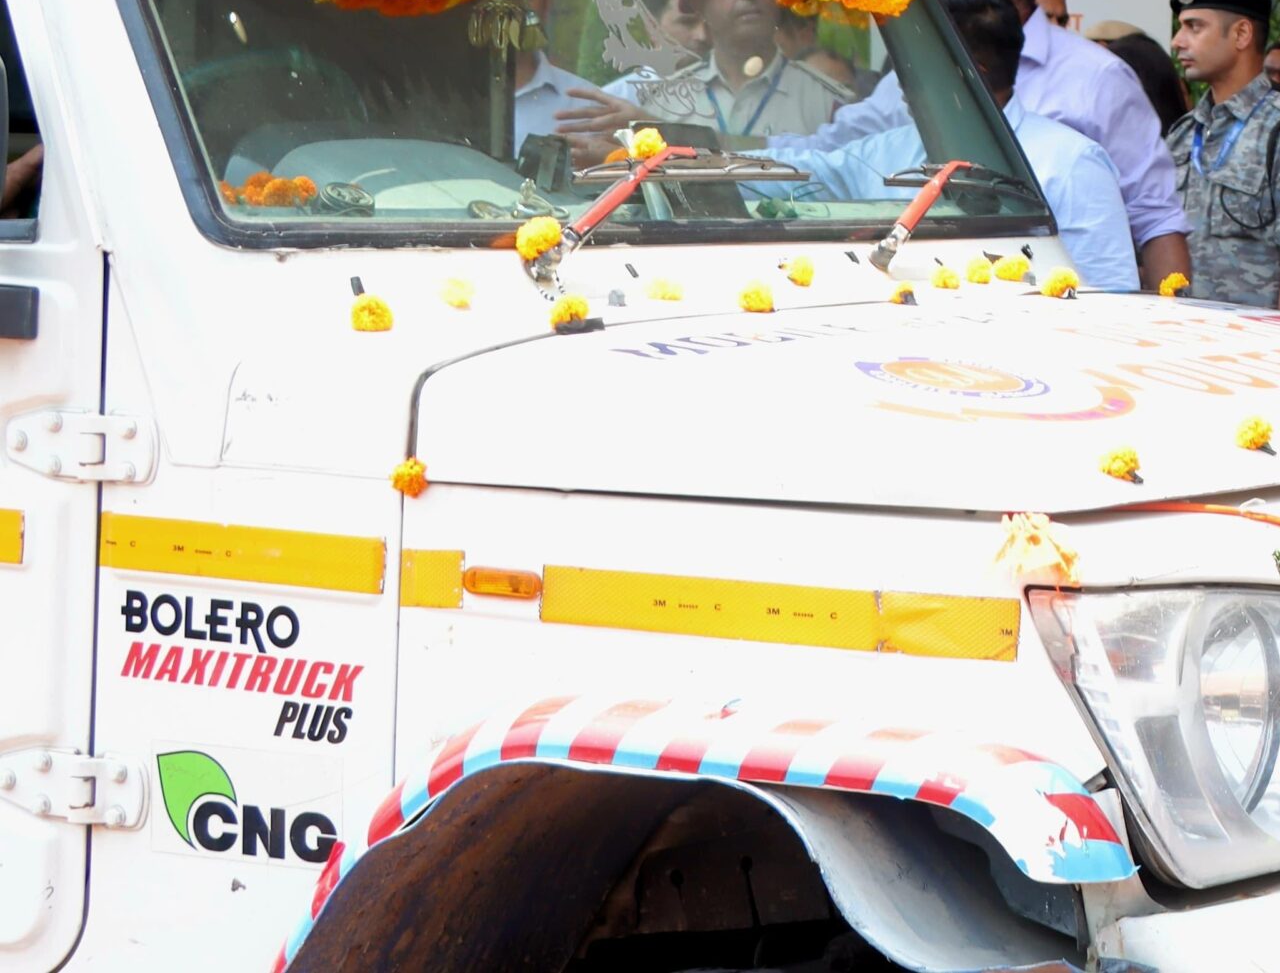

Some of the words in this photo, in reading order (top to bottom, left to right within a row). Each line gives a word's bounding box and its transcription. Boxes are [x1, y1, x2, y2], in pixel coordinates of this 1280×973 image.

[121, 590, 300, 653] BOLERO
[653, 599, 666, 607] 3M
[766, 608, 780, 616] 3M
[830, 612, 837, 620] C
[120, 641, 365, 702] MAXITRUCK
[273, 701, 353, 745] PLUS
[193, 801, 337, 864] CNG
